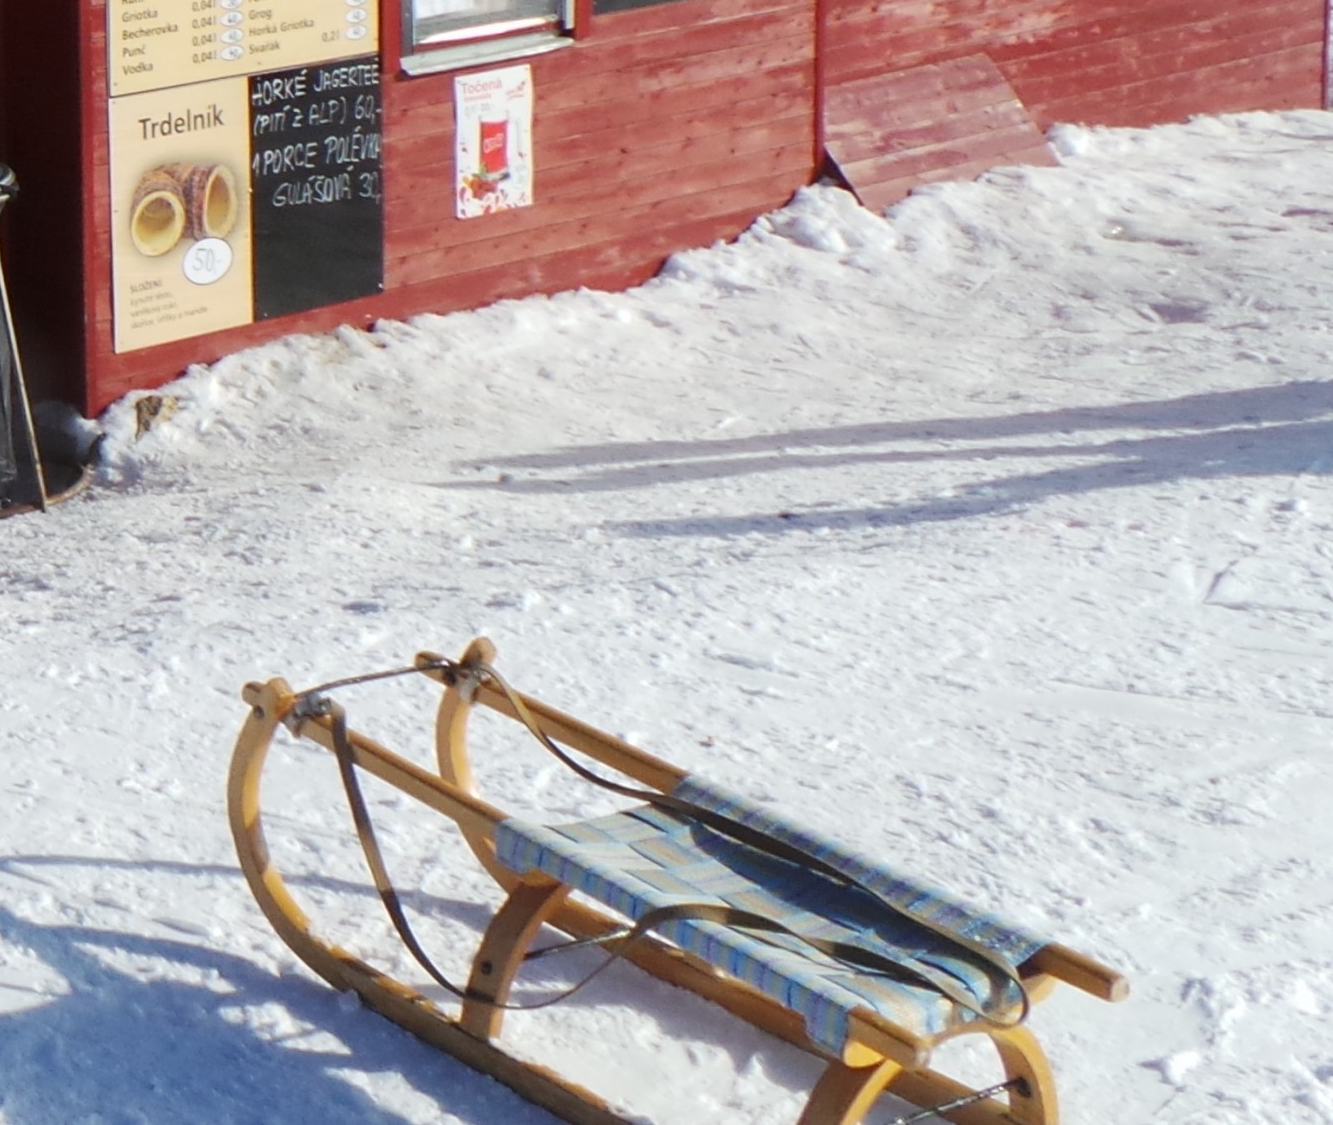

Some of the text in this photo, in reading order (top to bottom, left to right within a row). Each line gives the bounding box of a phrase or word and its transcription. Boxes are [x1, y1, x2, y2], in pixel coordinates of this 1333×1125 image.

[249, 9, 272, 20] Grog
[122, 23, 178, 41] Becherovka
[122, 62, 154, 76] Vodka
[138, 104, 224, 140] Trdelník
[263, 142, 318, 176] PORCE
